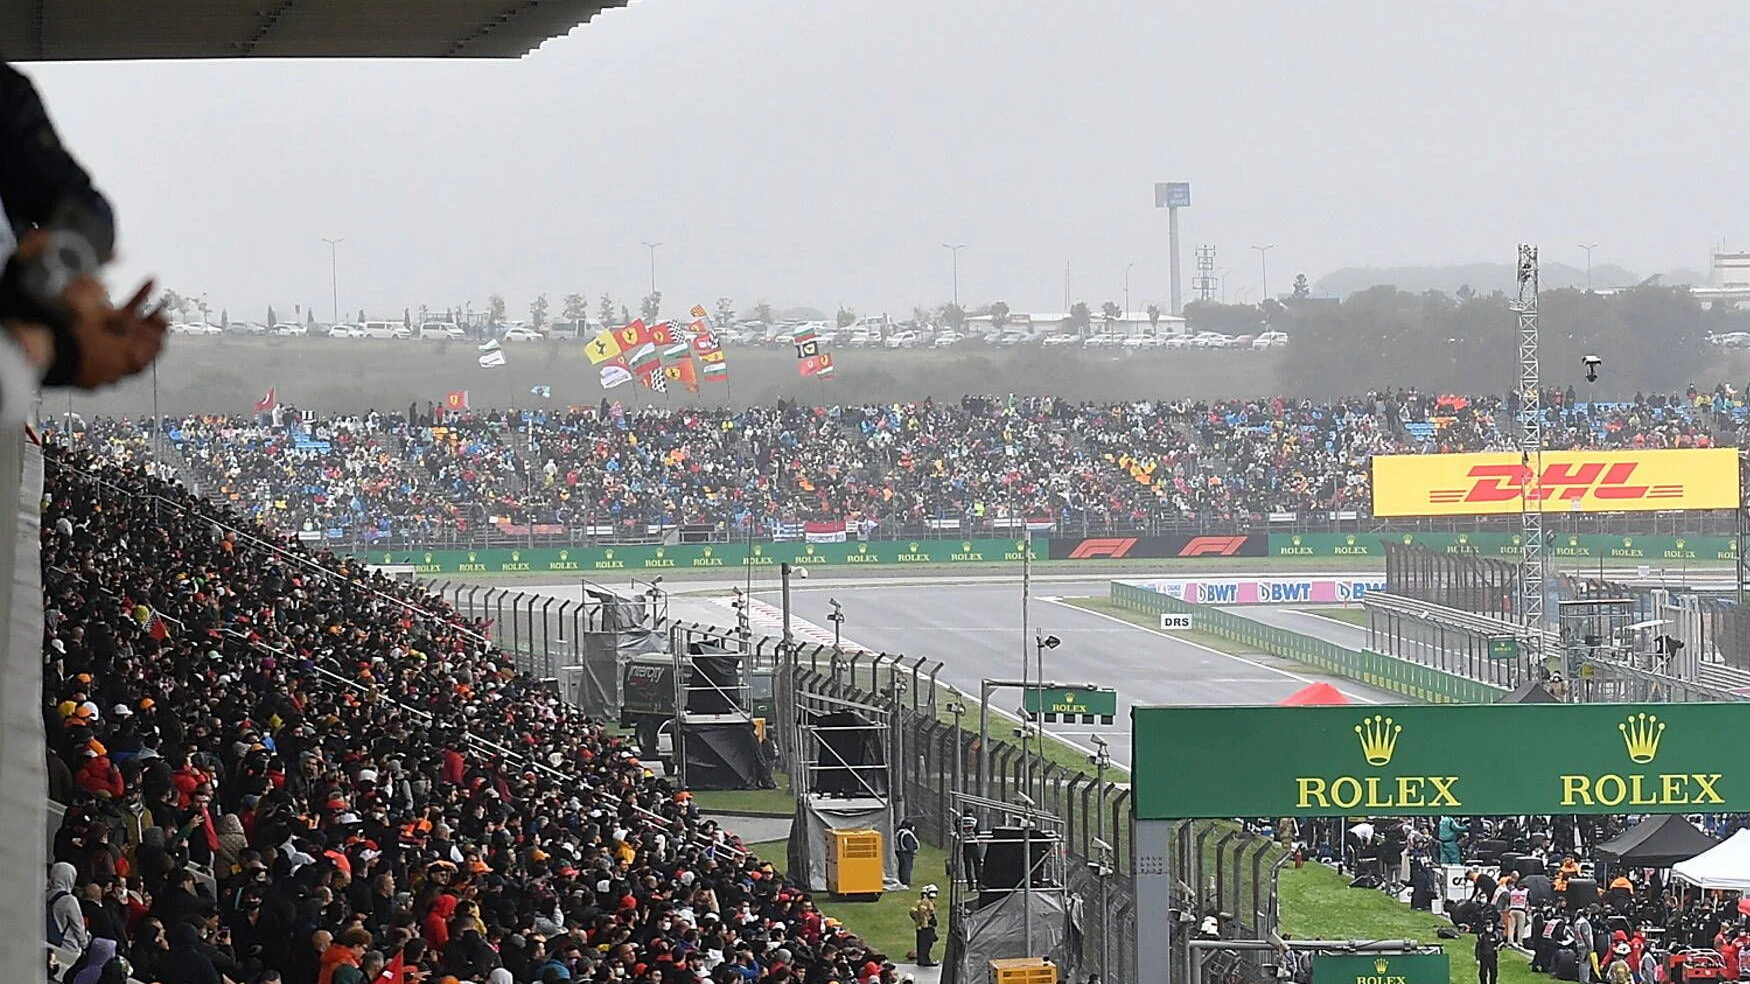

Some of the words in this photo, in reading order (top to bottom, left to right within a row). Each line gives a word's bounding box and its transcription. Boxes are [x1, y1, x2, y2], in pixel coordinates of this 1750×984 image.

[1464, 462, 1649, 502] DHL
[1207, 584, 1237, 601] BWT
[1271, 583, 1310, 600] BWT
[1353, 583, 1388, 599] BW
[1165, 618, 1189, 627] DRS
[1052, 704, 1087, 712] ROLEX
[1295, 776, 1463, 809] ROLEX
[1559, 773, 1726, 806] ROLEX
